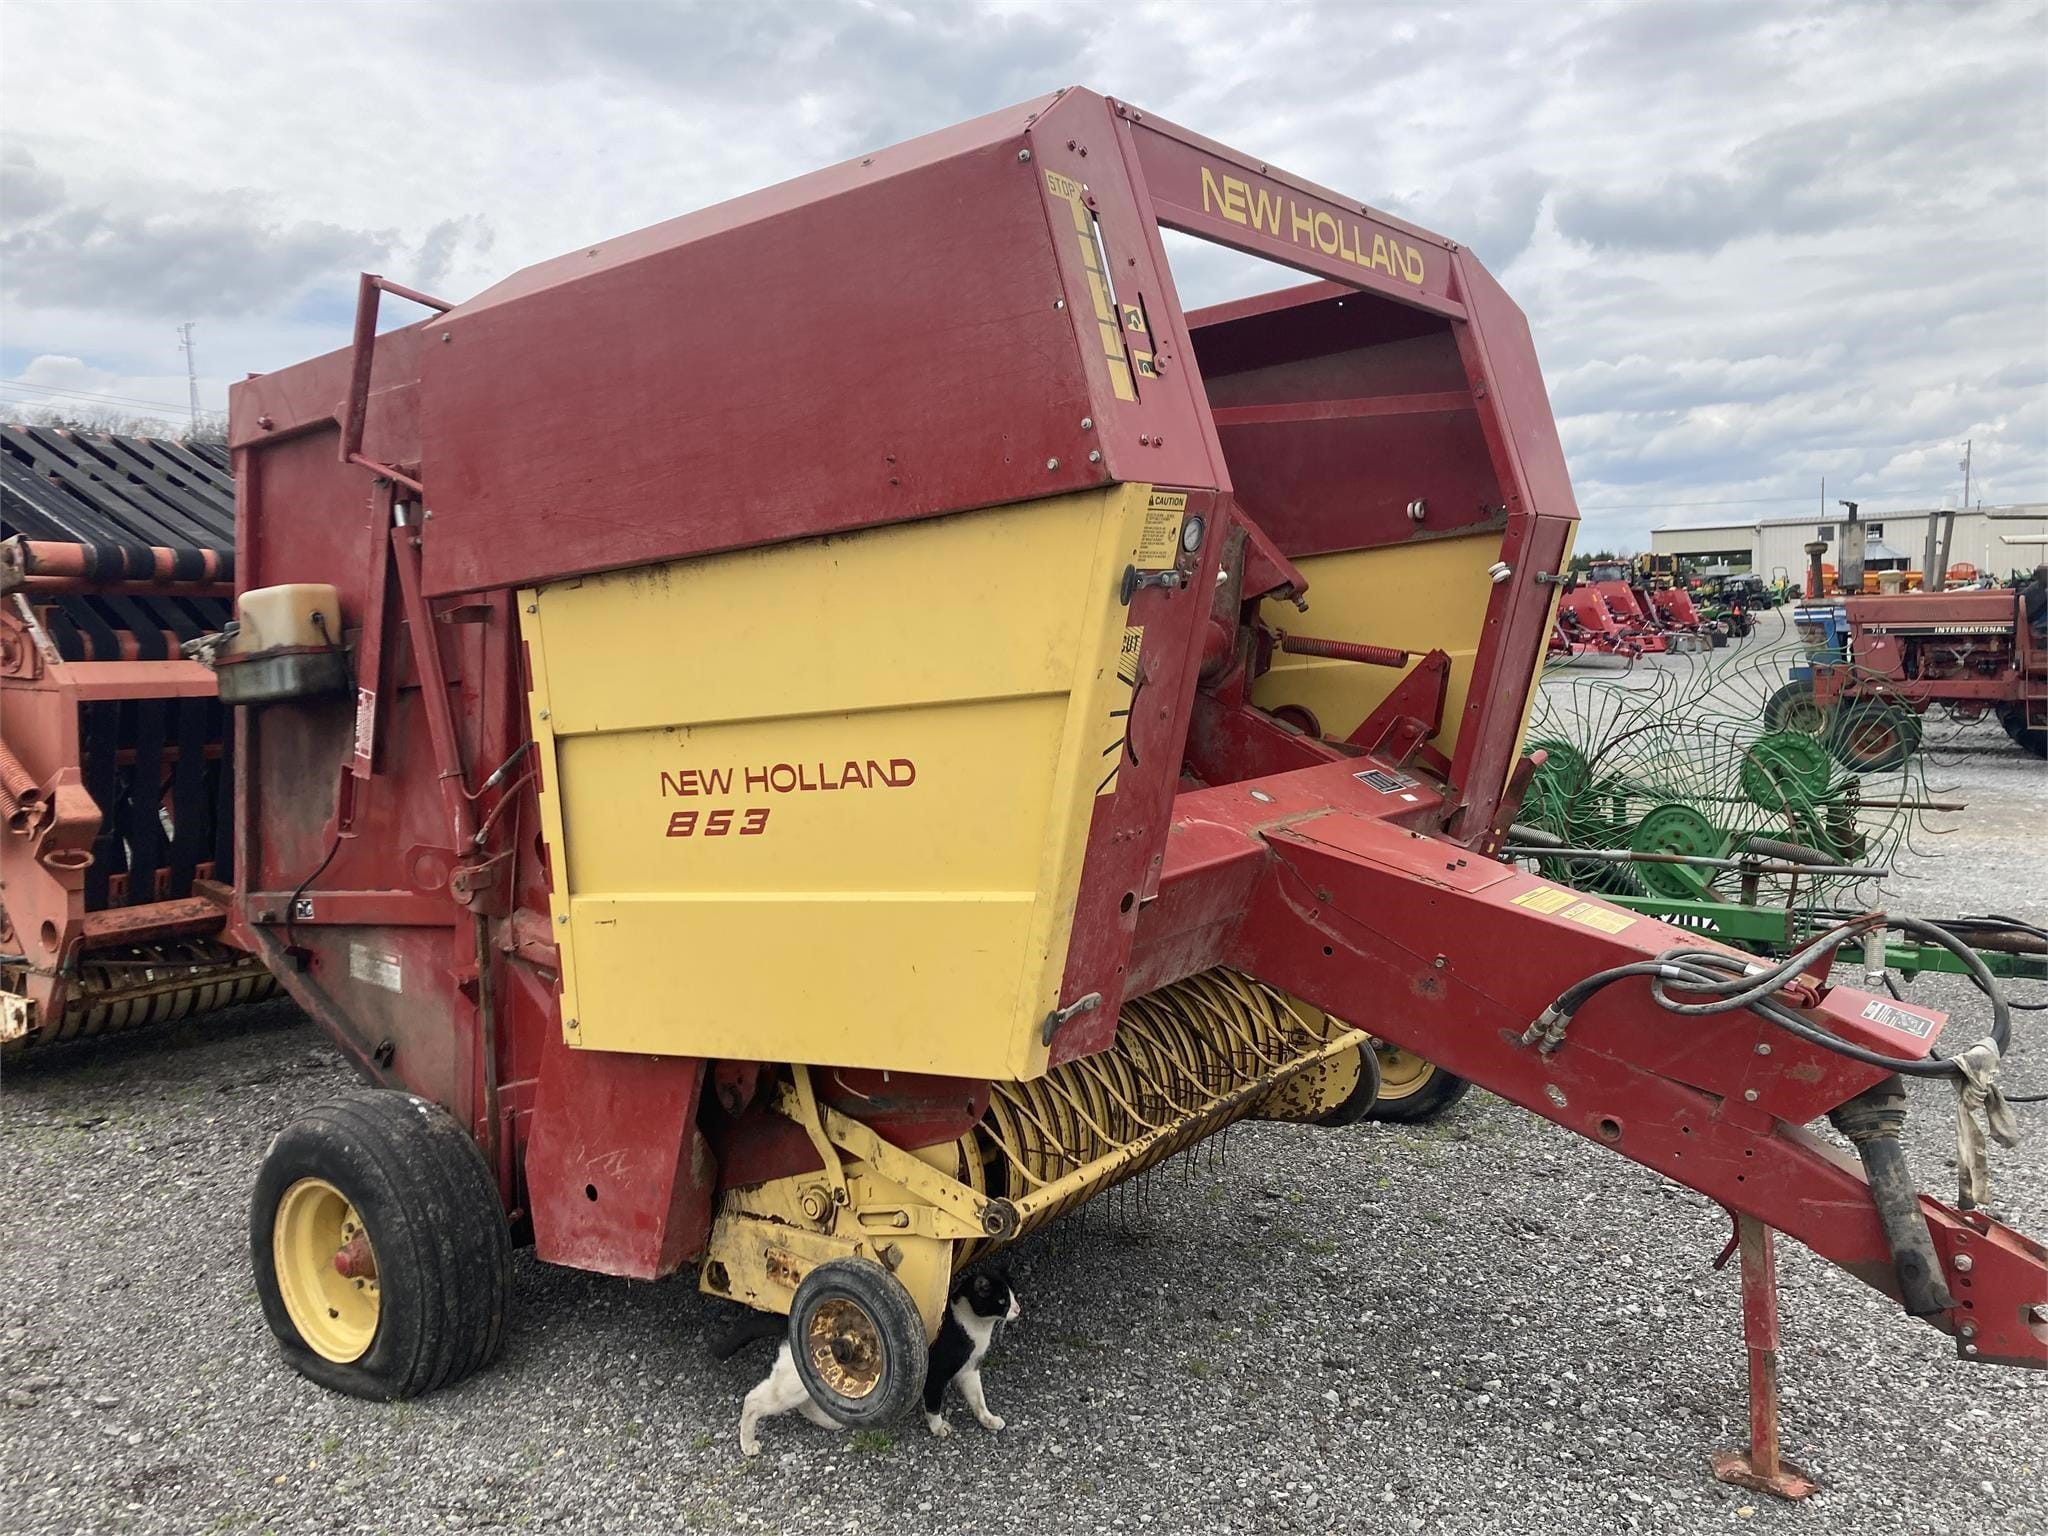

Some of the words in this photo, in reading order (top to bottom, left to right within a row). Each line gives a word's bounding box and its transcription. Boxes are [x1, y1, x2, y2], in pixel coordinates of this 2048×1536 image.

[1047, 174, 1076, 198] STOP
[1201, 166, 1282, 236] NEW
[1291, 200, 1425, 285] HOLLAND
[1155, 496, 1184, 506] CAUTION
[1934, 626, 2007, 634] INTERNATIONAL
[660, 768, 733, 797] NEW
[744, 758, 916, 793] HOLLAND
[665, 808, 770, 837] 853
